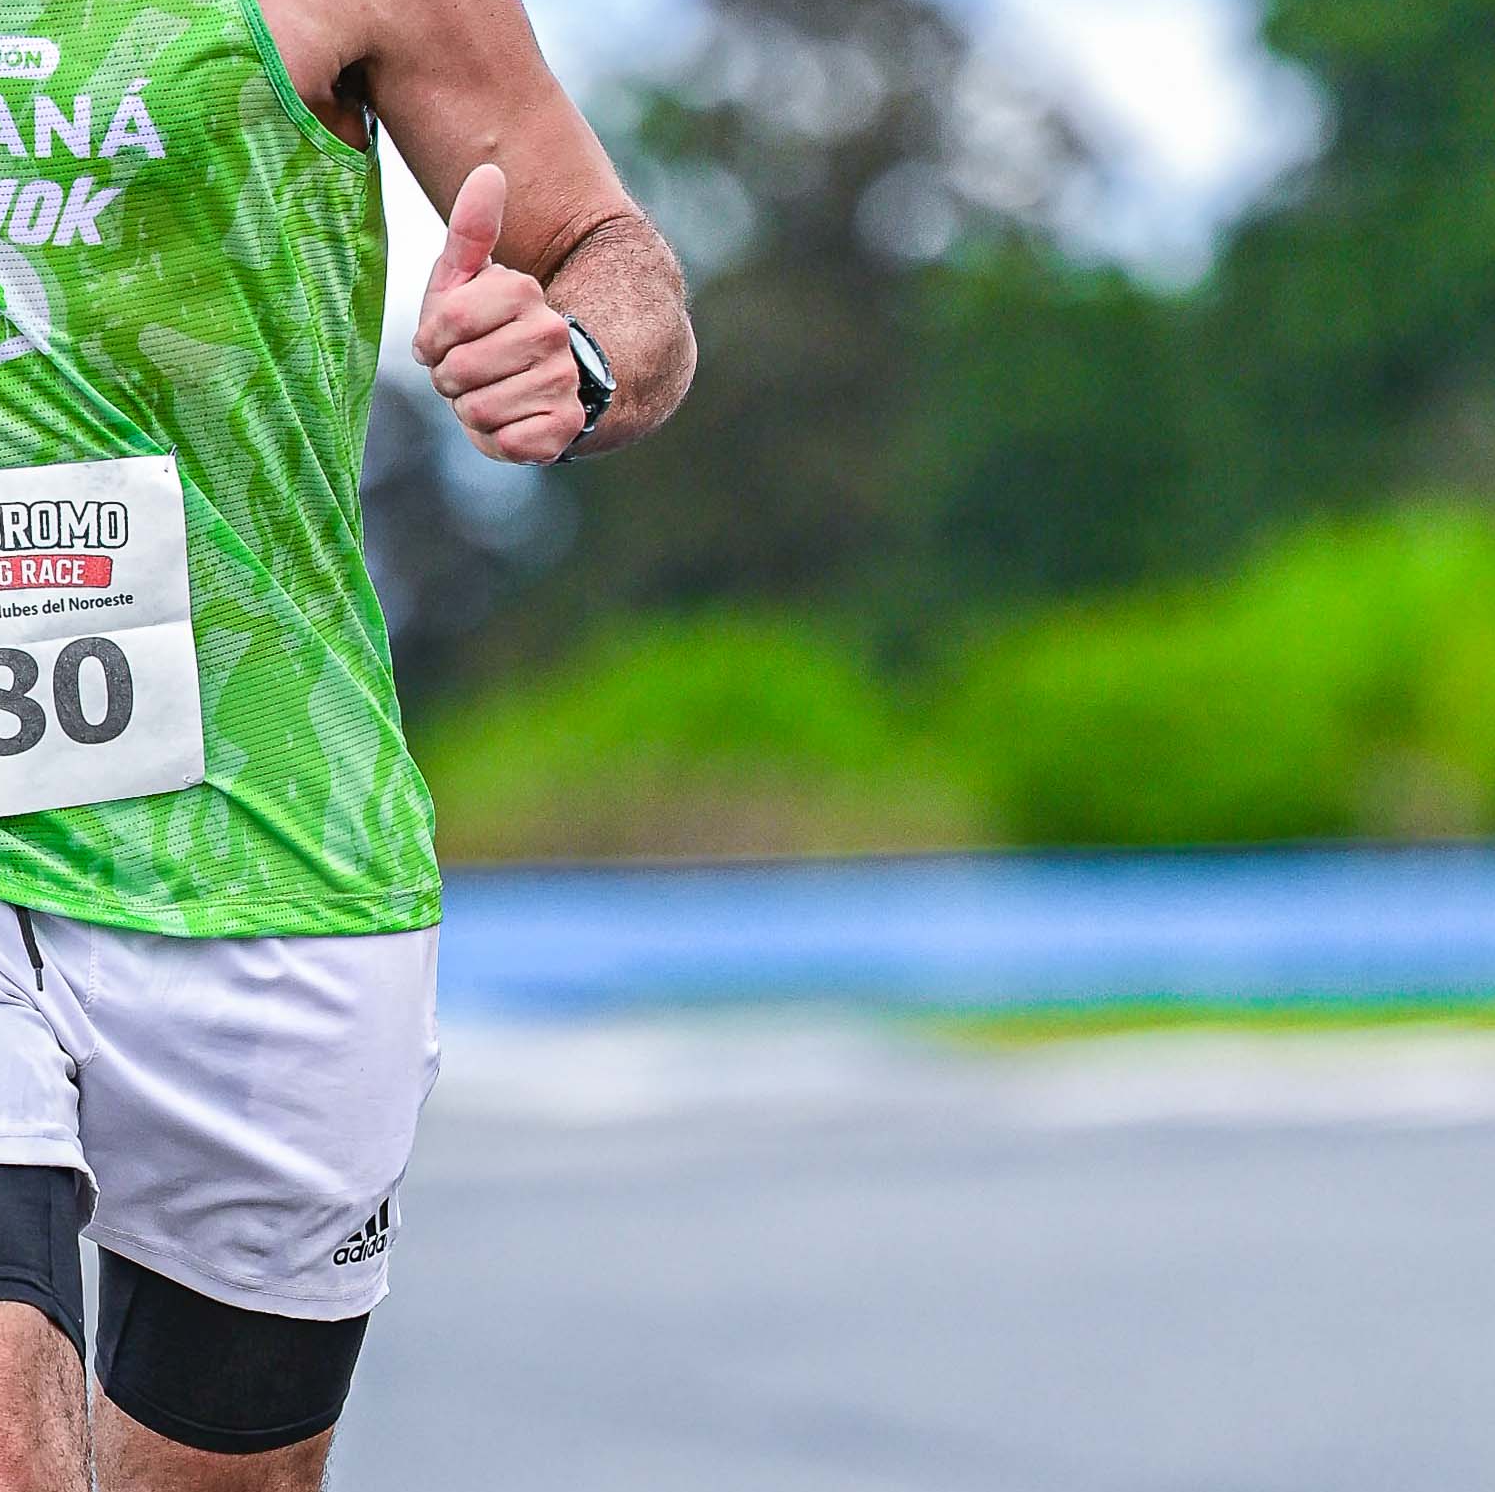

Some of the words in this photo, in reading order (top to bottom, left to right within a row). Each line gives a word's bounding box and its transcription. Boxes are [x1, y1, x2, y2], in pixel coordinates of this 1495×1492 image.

[21, 559, 85, 585] RACE
[42, 598, 65, 614] del
[69, 591, 134, 612] Noroeste
[332, 1233, 388, 1266] adida
